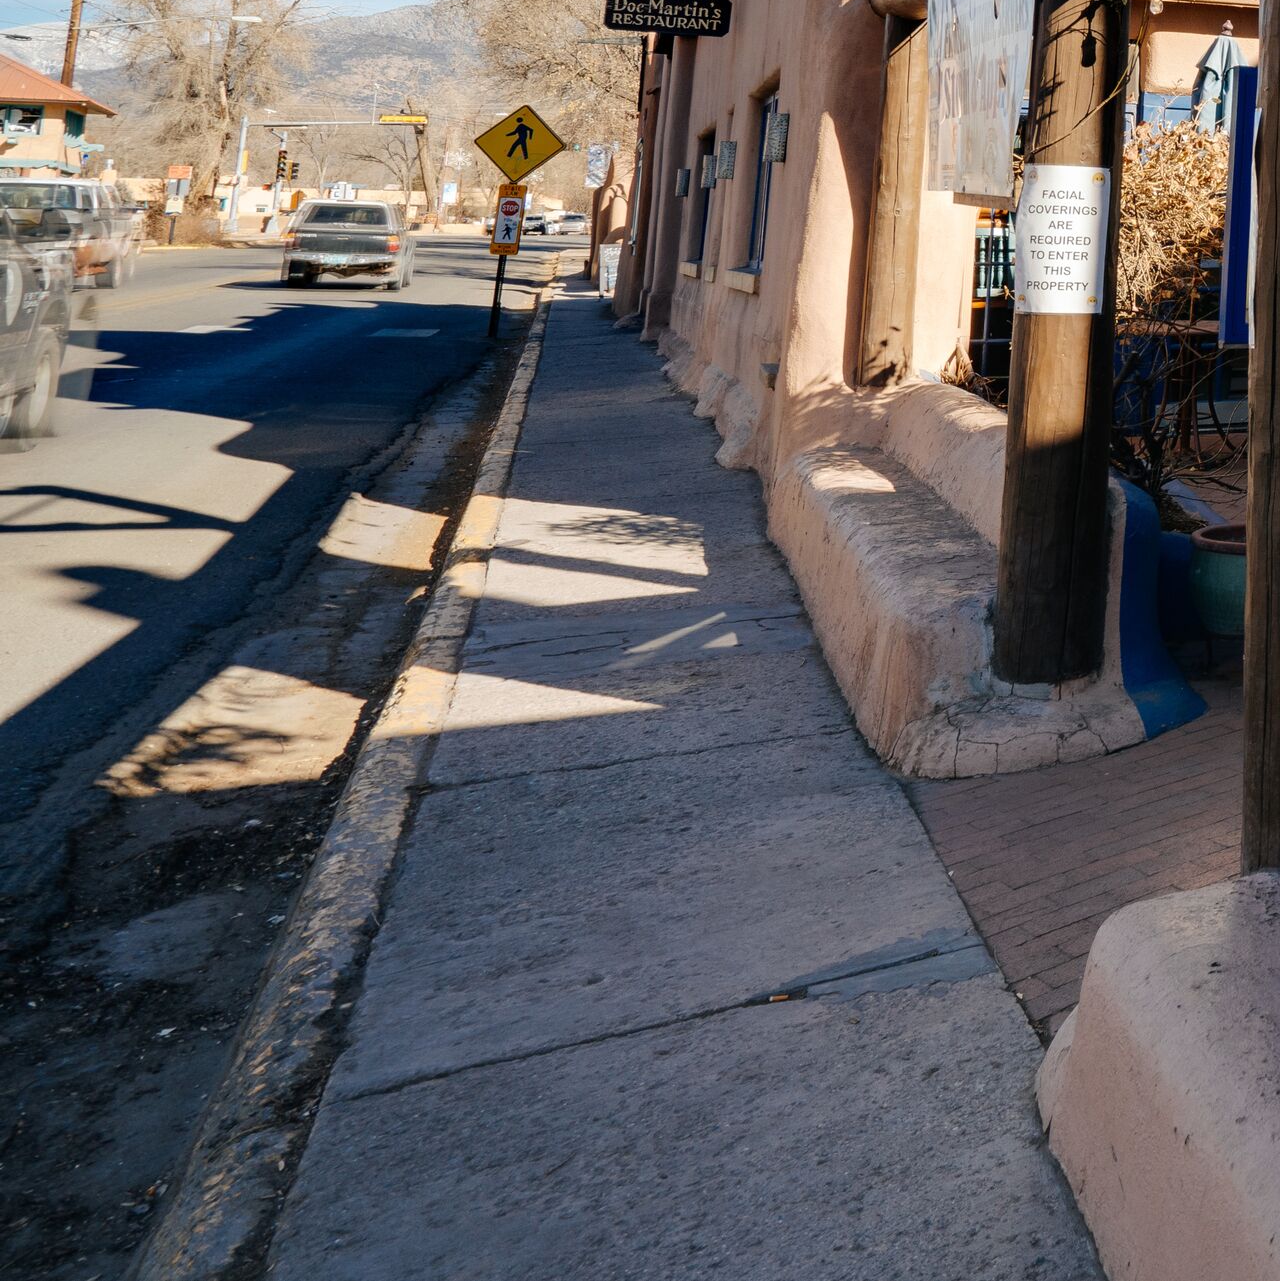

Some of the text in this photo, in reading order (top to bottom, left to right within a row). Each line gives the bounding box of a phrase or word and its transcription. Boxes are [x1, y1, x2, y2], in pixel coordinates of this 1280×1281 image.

[611, 12, 722, 31] RESTAURANT
[1042, 190, 1085, 200] FACIAL
[501, 204, 519, 212] STOP
[1028, 205, 1098, 216] COVERINGS
[1048, 220, 1073, 230] ARE
[1030, 235, 1091, 246] REQUIRED
[1030, 250, 1089, 261] TO ENTER
[1044, 266, 1071, 276] THIS
[1026, 280, 1089, 291] PROPERTY
